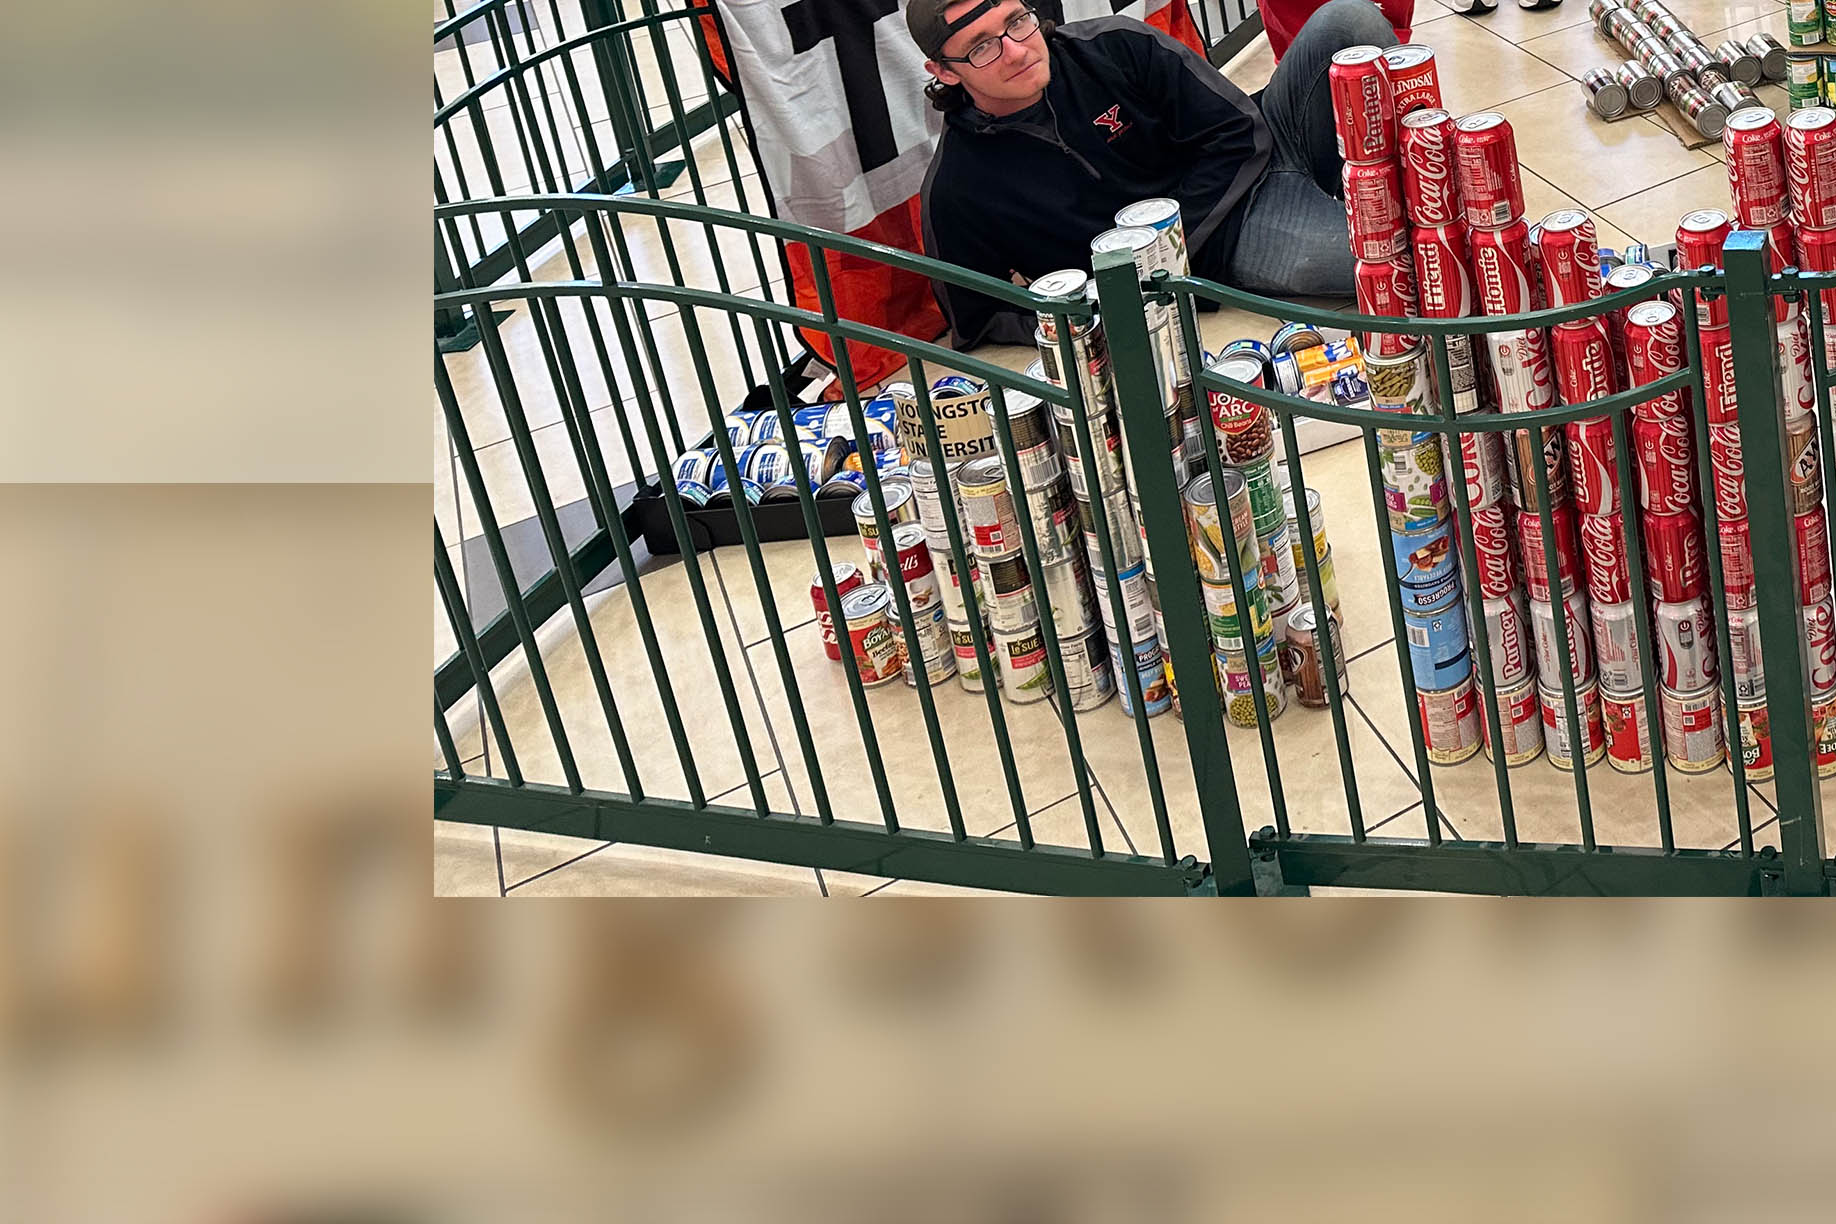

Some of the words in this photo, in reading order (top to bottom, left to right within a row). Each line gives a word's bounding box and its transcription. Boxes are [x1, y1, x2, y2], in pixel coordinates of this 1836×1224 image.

[1742, 133, 1761, 143] Coke
[1814, 131, 1832, 142] Coke
[1357, 168, 1378, 178] Coke
[1219, 402, 1254, 418] ARC
[902, 421, 948, 438] STAE
[907, 436, 995, 457] UNERSIT
[1499, 611, 1522, 680] Partner
